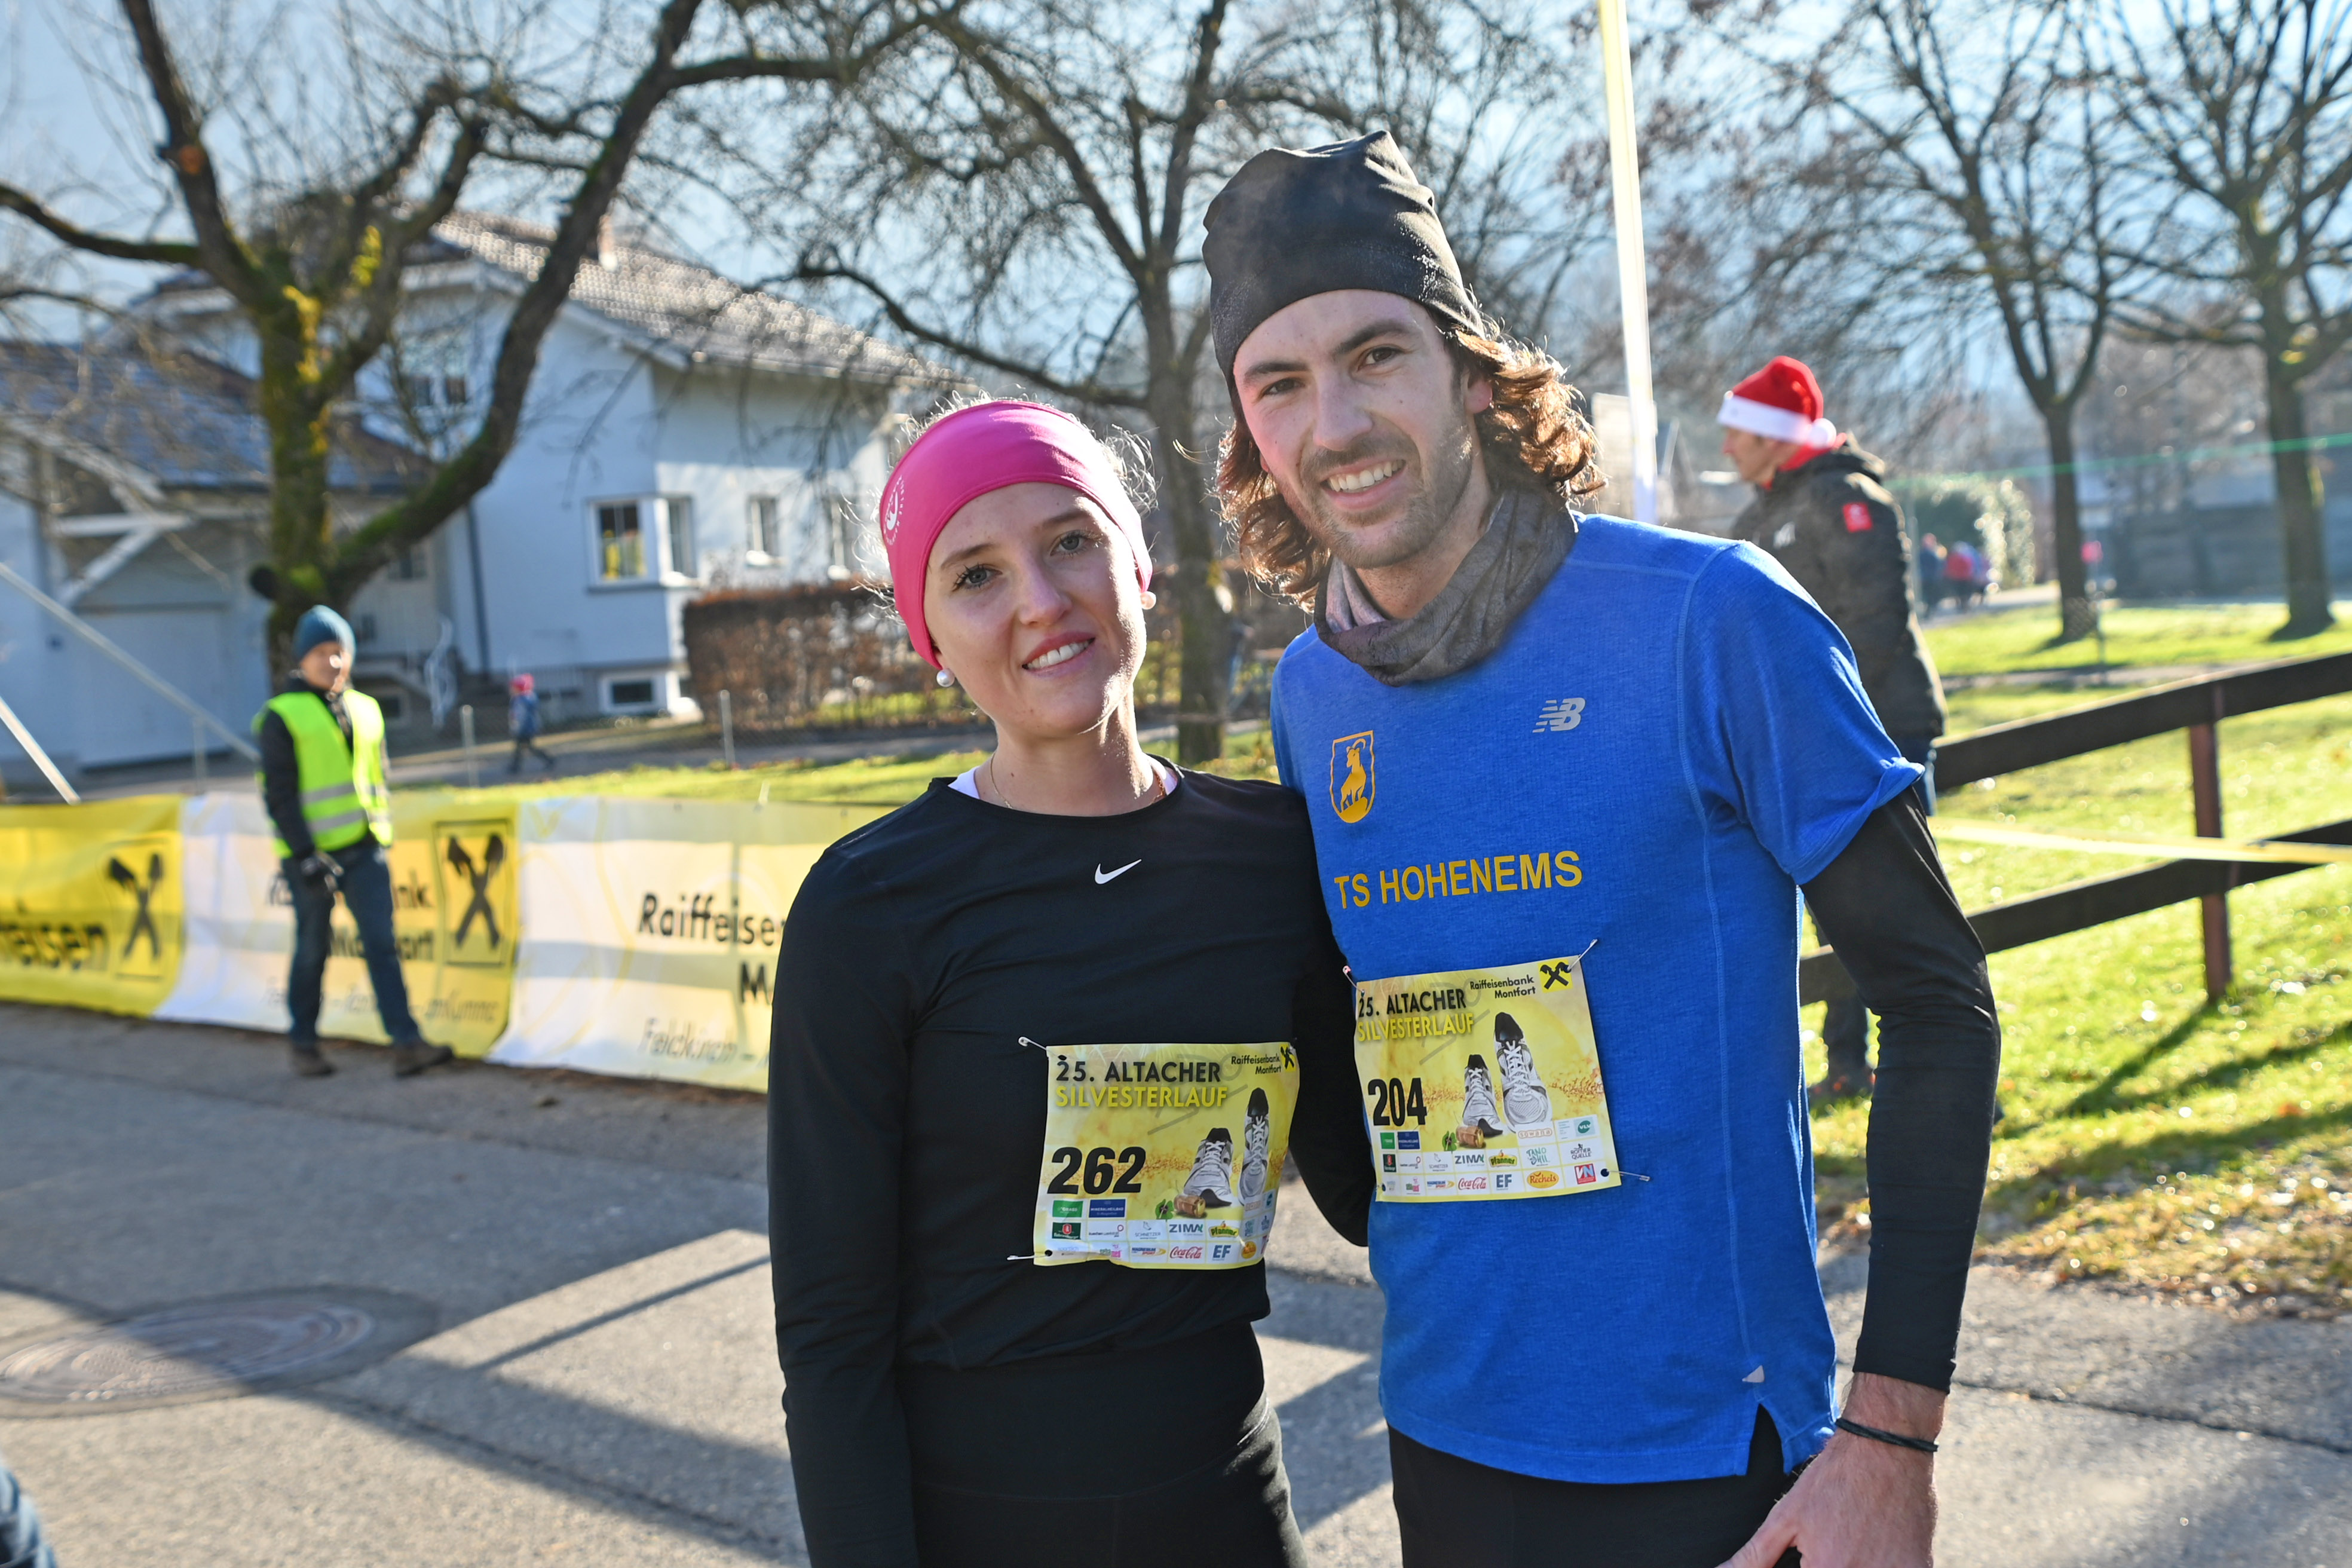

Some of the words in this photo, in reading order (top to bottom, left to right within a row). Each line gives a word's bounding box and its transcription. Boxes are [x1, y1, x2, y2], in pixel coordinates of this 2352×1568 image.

[1334, 873, 1370, 909] TS
[1380, 850, 1582, 904] HOHENEMS
[638, 893, 786, 947] Raiffeise
[1470, 974, 1534, 990] Raiffeisenbank
[1359, 996, 1380, 1017] 25.
[1386, 988, 1467, 1015] ALTACHER
[1495, 987, 1536, 999] Montfort
[1357, 1013, 1474, 1042] SILVESTERLAUF
[1056, 1061, 1094, 1082] 25.
[1105, 1061, 1221, 1083] ALTACHER
[1055, 1086, 1228, 1107] SILVESTERLAUF
[1368, 1077, 1427, 1126] 204
[1454, 1154, 1484, 1164] ZIMA
[1047, 1147, 1146, 1195] 262
[1496, 1174, 1512, 1188] EF
[1169, 1224, 1203, 1233] ZIMA
[1212, 1245, 1232, 1258] EF
